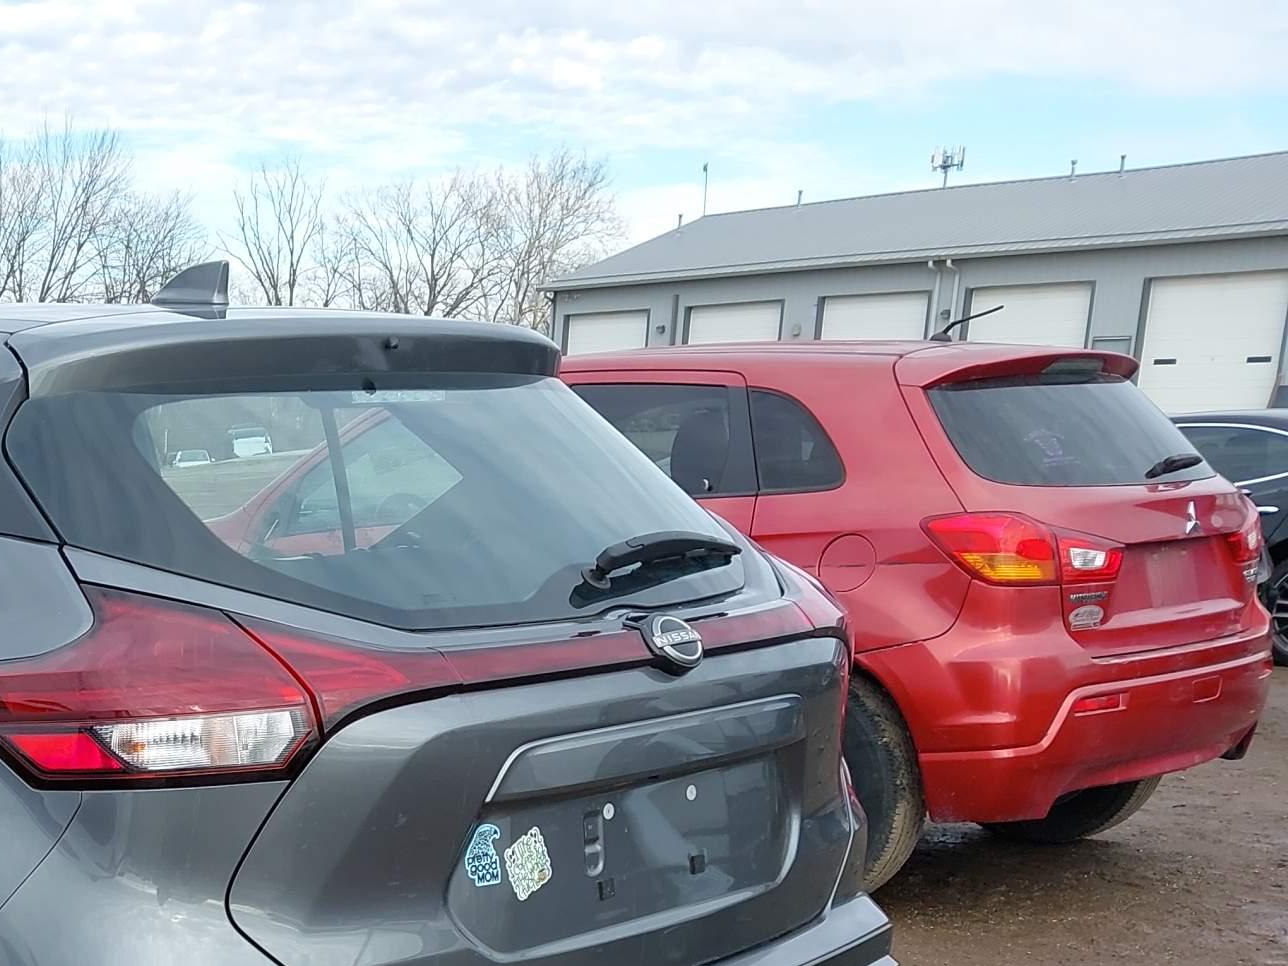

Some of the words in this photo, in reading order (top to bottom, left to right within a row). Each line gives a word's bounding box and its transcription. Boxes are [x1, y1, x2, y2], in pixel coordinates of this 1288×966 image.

[467, 851, 495, 867] pretty
[470, 859, 497, 876] good
[477, 870, 499, 885] MOM
